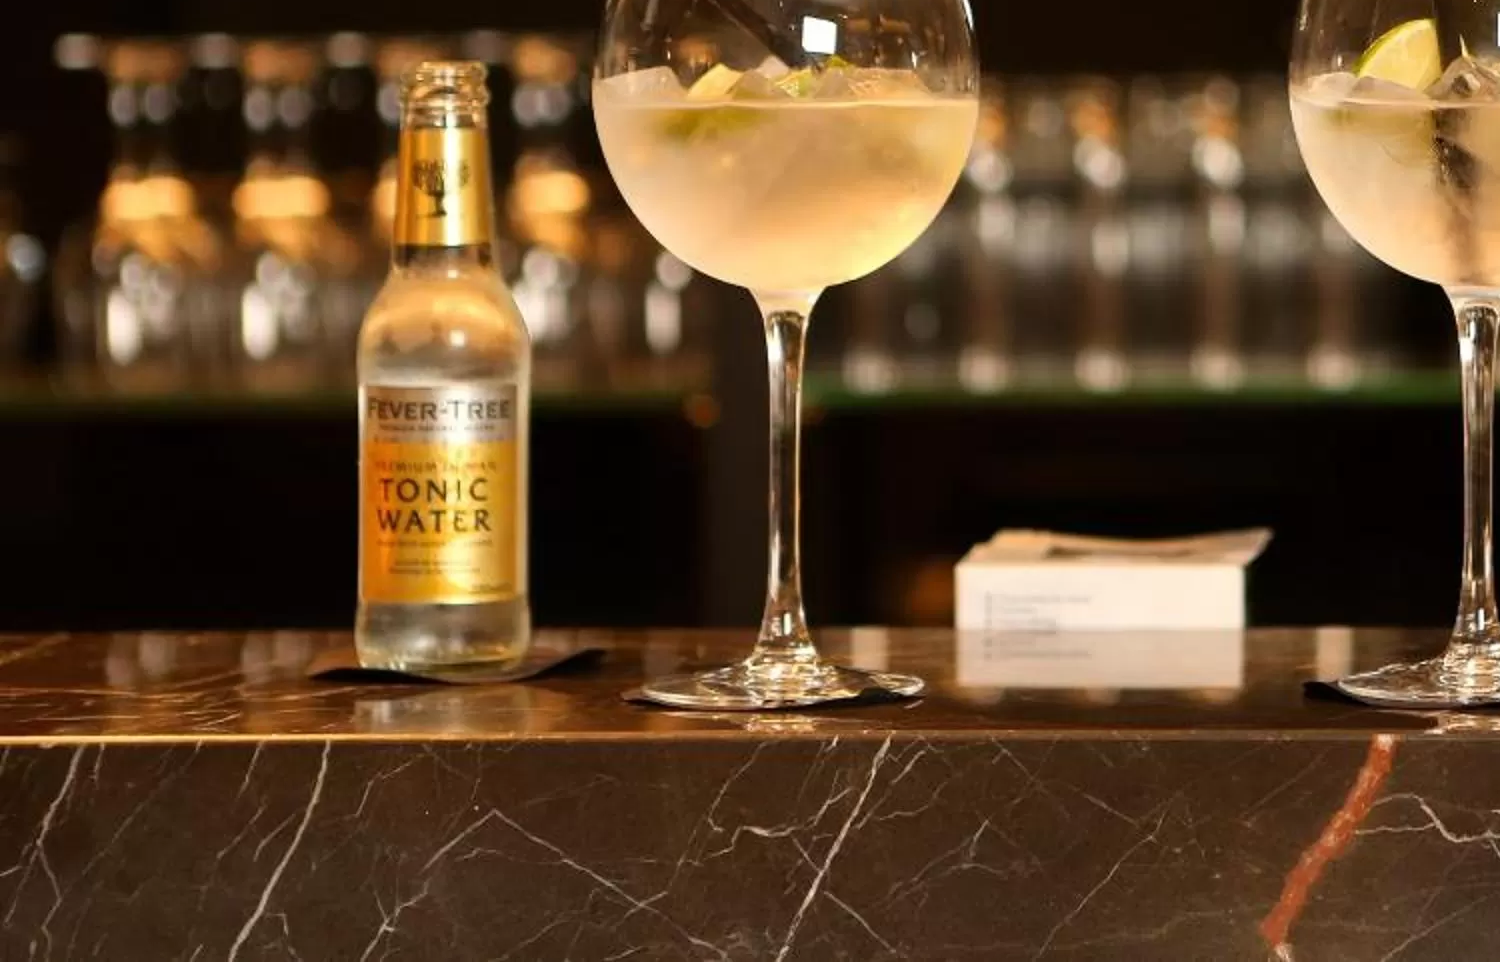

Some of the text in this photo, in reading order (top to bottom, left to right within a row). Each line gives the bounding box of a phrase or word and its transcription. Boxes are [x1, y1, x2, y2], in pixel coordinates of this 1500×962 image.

[368, 397, 510, 421] FEVER-TREE
[379, 477, 488, 503] TONIC
[376, 509, 492, 533] WATER
